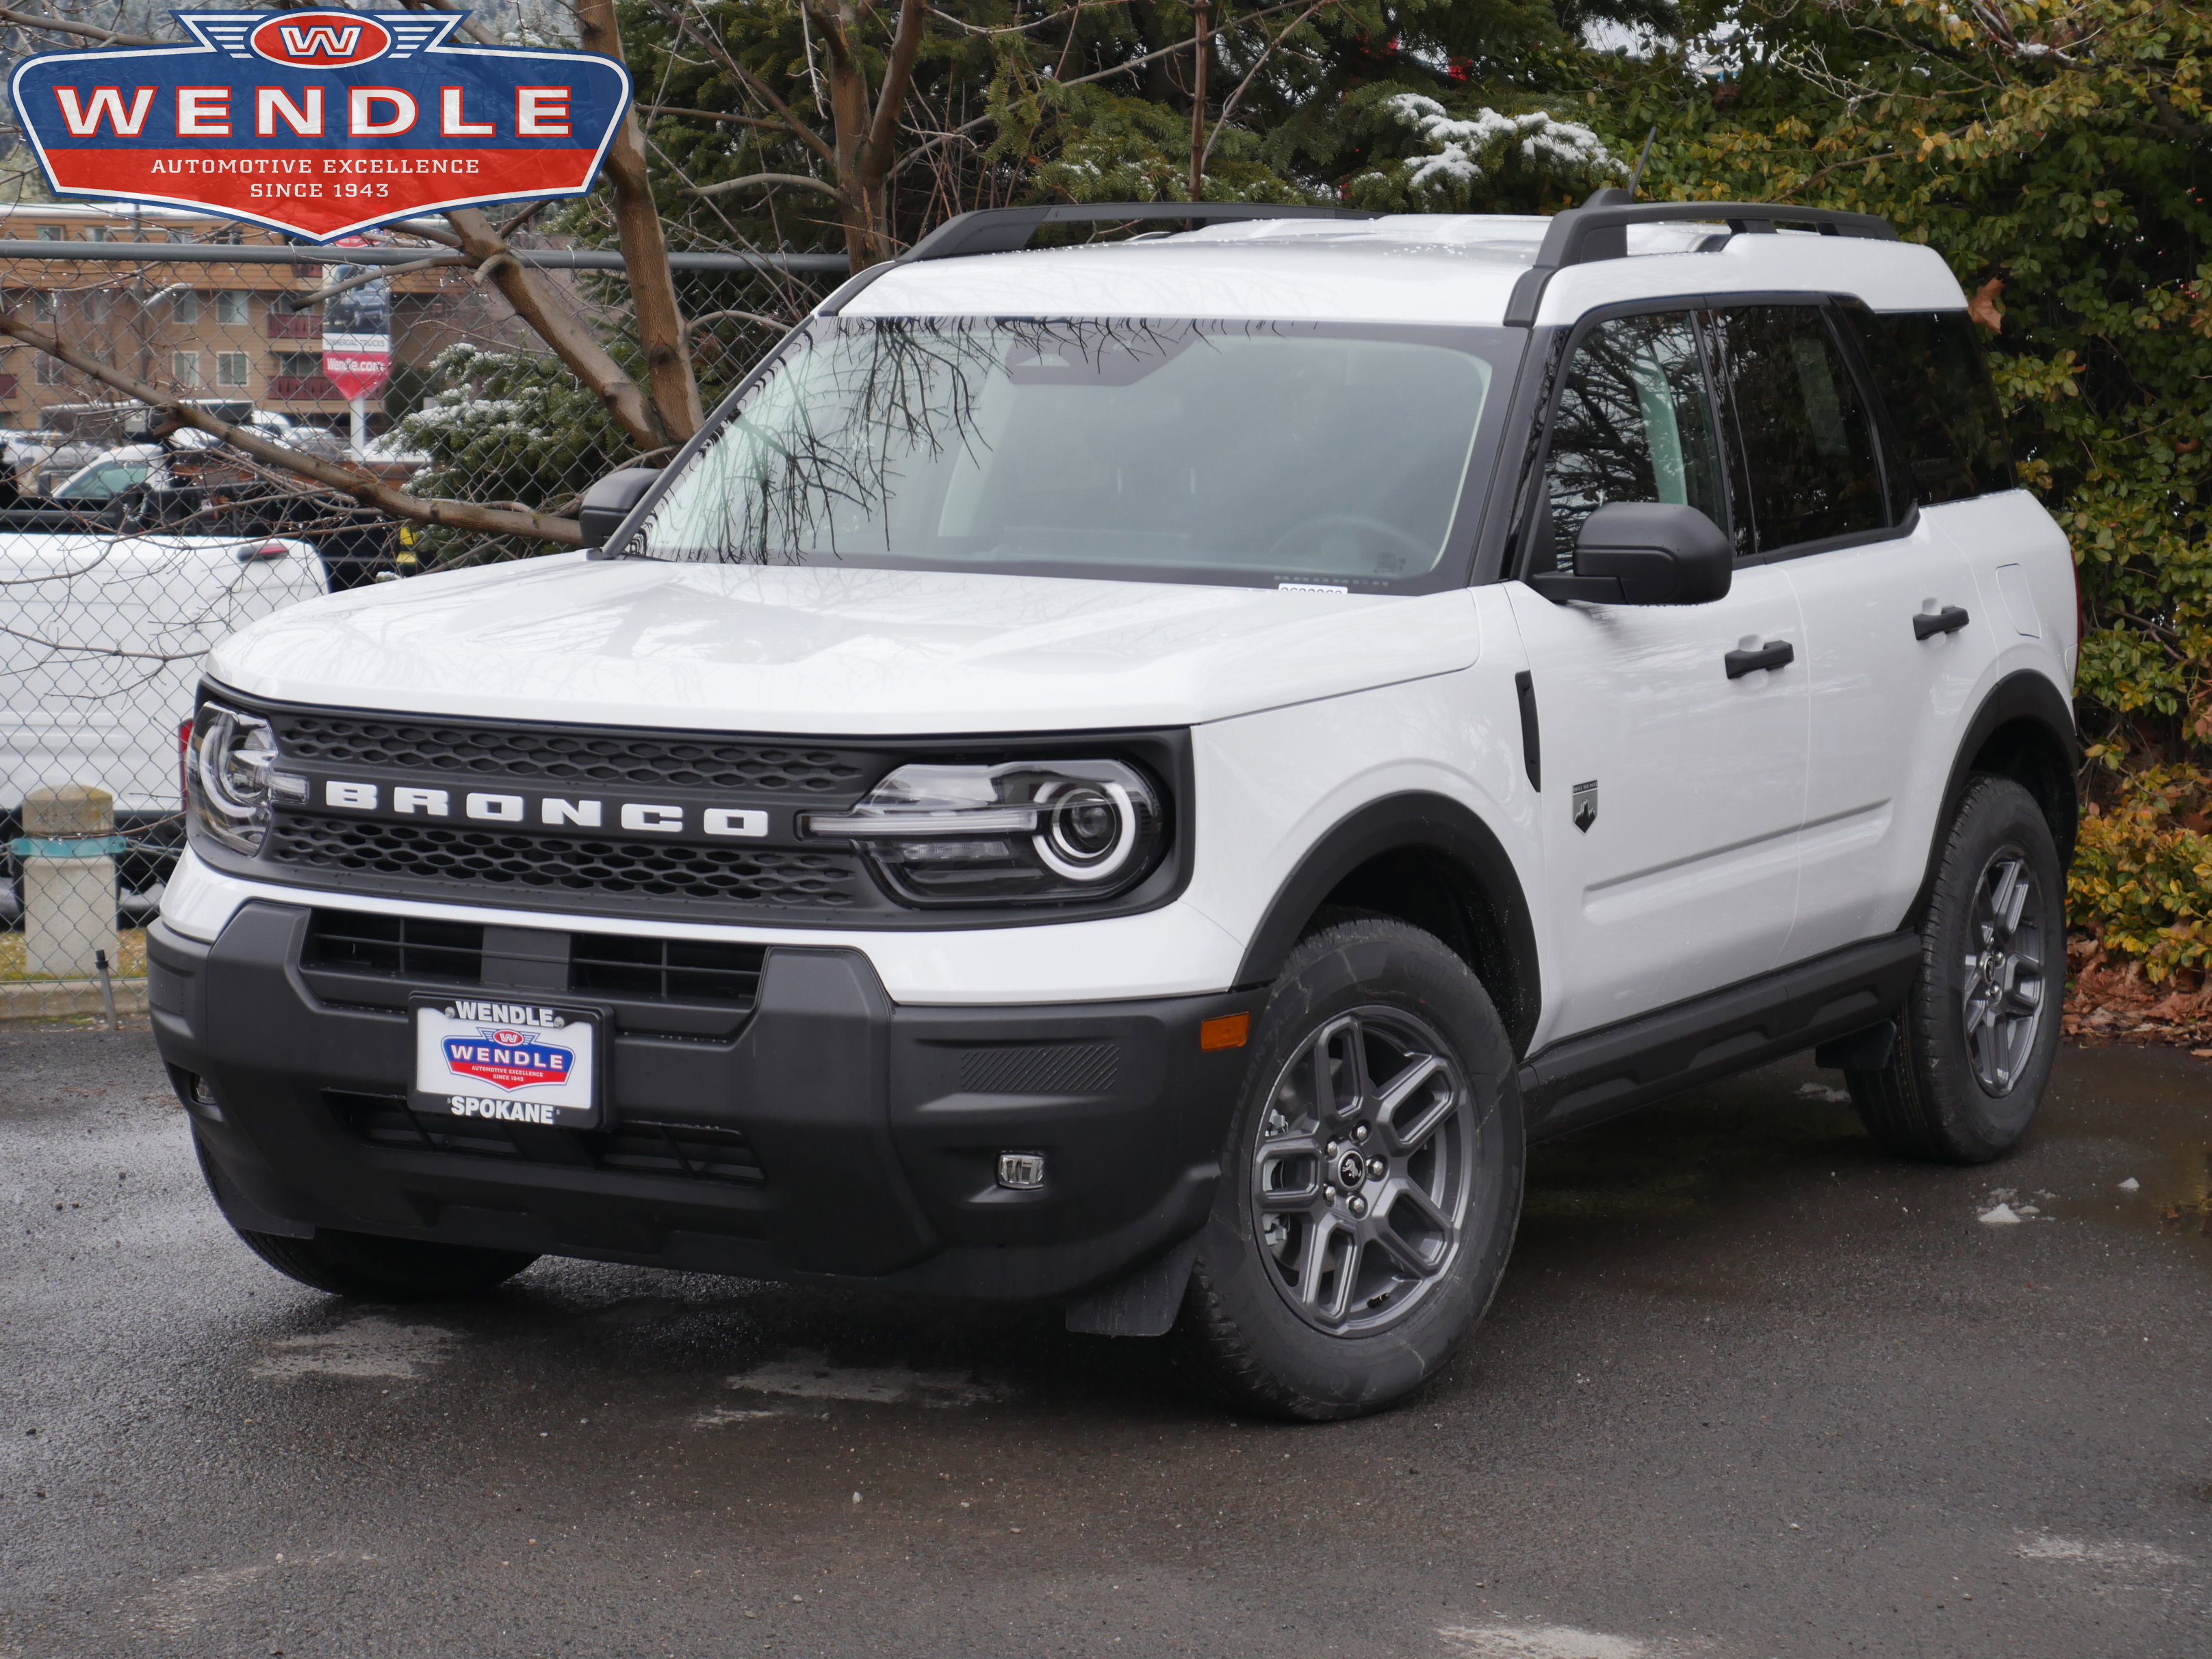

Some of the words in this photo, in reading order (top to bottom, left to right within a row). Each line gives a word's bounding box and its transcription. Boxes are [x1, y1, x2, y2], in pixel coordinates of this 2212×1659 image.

[325, 780, 769, 837] BRONCO
[455, 1001, 554, 1027] WENDLE
[450, 1044, 563, 1069] WENDLE
[472, 1066, 507, 1074] AUTOMOTIVE
[509, 1069, 543, 1077] EXCELLENCE
[450, 1096, 553, 1124] SPOKANE
